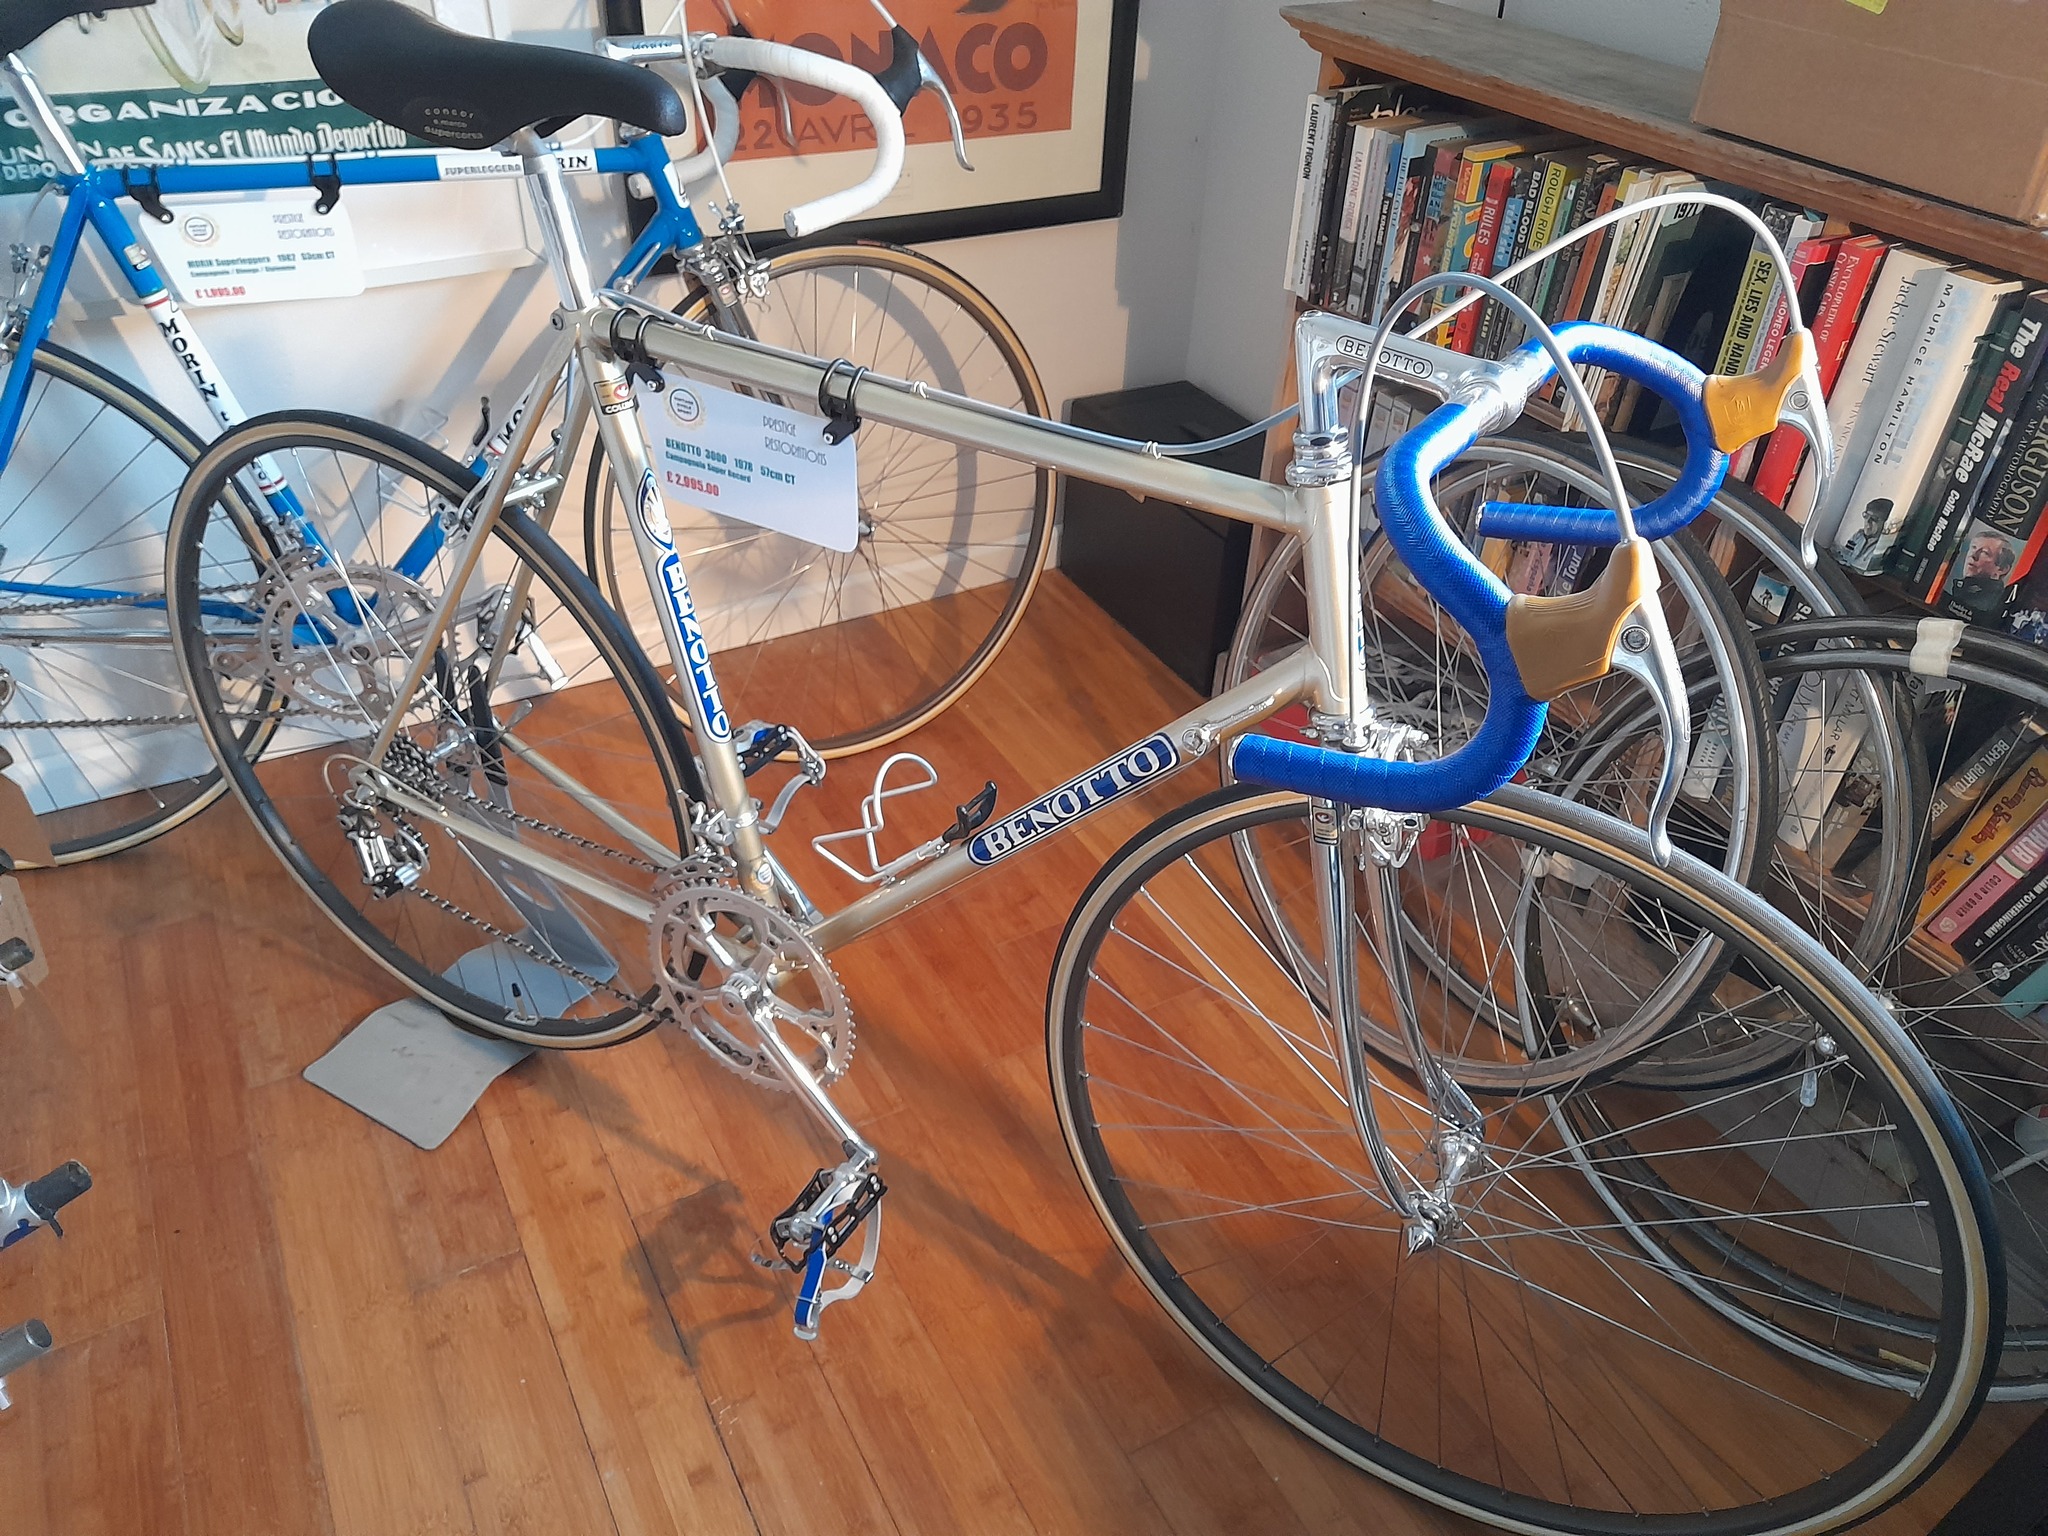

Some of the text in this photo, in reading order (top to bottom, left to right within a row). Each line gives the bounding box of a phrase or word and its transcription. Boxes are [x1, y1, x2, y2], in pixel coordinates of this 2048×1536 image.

[949, 101, 1038, 136] 935
[245, 125, 317, 158] Mundo
[1303, 103, 1320, 180] LAURENT FIGNON
[1528, 171, 1541, 199] BAD
[1477, 207, 1496, 246] RULES
[1517, 200, 1534, 244] BLOOD
[1532, 167, 1561, 249] ROUGH RIDE
[1752, 259, 1772, 286] SEX,
[1828, 252, 1848, 292] CLASSIC
[1744, 290, 1763, 315] LIES
[1827, 255, 1860, 331] ENCYCLOPAEDIA
[1737, 315, 1755, 340] AND
[1771, 301, 1788, 336] ROMEO
[1862, 276, 1918, 383] Jackie Stewart
[158, 318, 220, 402] MORIN
[1343, 339, 1427, 376] BEOTTO
[1873, 283, 1954, 465] MAURICE HAMILTON
[762, 415, 797, 437] PRESTIGE
[1926, 317, 2042, 553] The Real McRae Colin McRae
[665, 437, 702, 457] BENOTTO
[705, 448, 728, 465] 3000
[760, 465, 783, 482] 57cm
[784, 473, 796, 485] CT
[665, 450, 706, 470] Campagnolo
[706, 463, 726, 476] Super
[764, 436, 827, 466] RESTORATIONS
[666, 470, 674, 483] £
[1985, 436, 2029, 523] AUTOBIOGRAPHY
[665, 563, 731, 738] BENOTTO
[1979, 738, 2010, 768] BERYL
[1949, 762, 1986, 799] BURTON
[980, 745, 1161, 859] BENOTTO
[1983, 889, 2037, 939] FOTHERINGHAM
